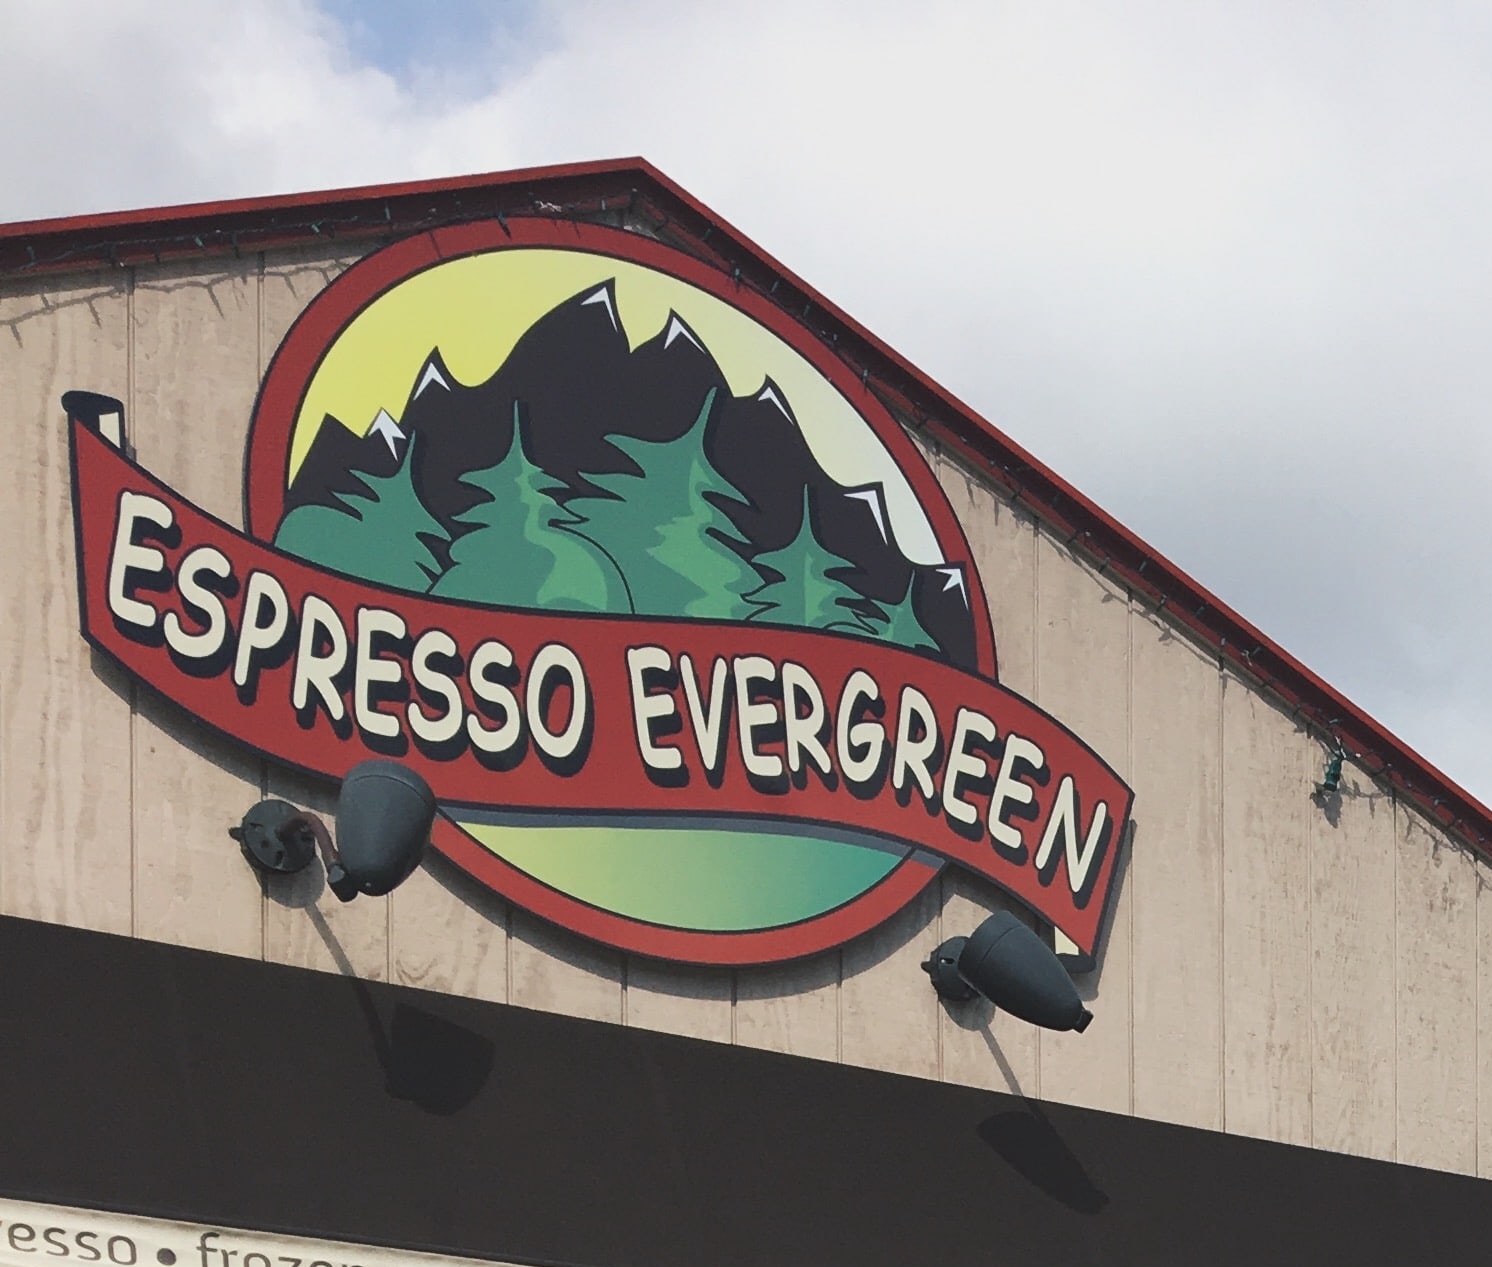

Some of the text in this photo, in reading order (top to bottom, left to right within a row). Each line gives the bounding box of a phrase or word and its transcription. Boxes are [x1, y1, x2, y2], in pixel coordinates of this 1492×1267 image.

[108, 489, 1110, 894] ESPRESSO EVERGREEN
[0, 1217, 138, 1267] esso
